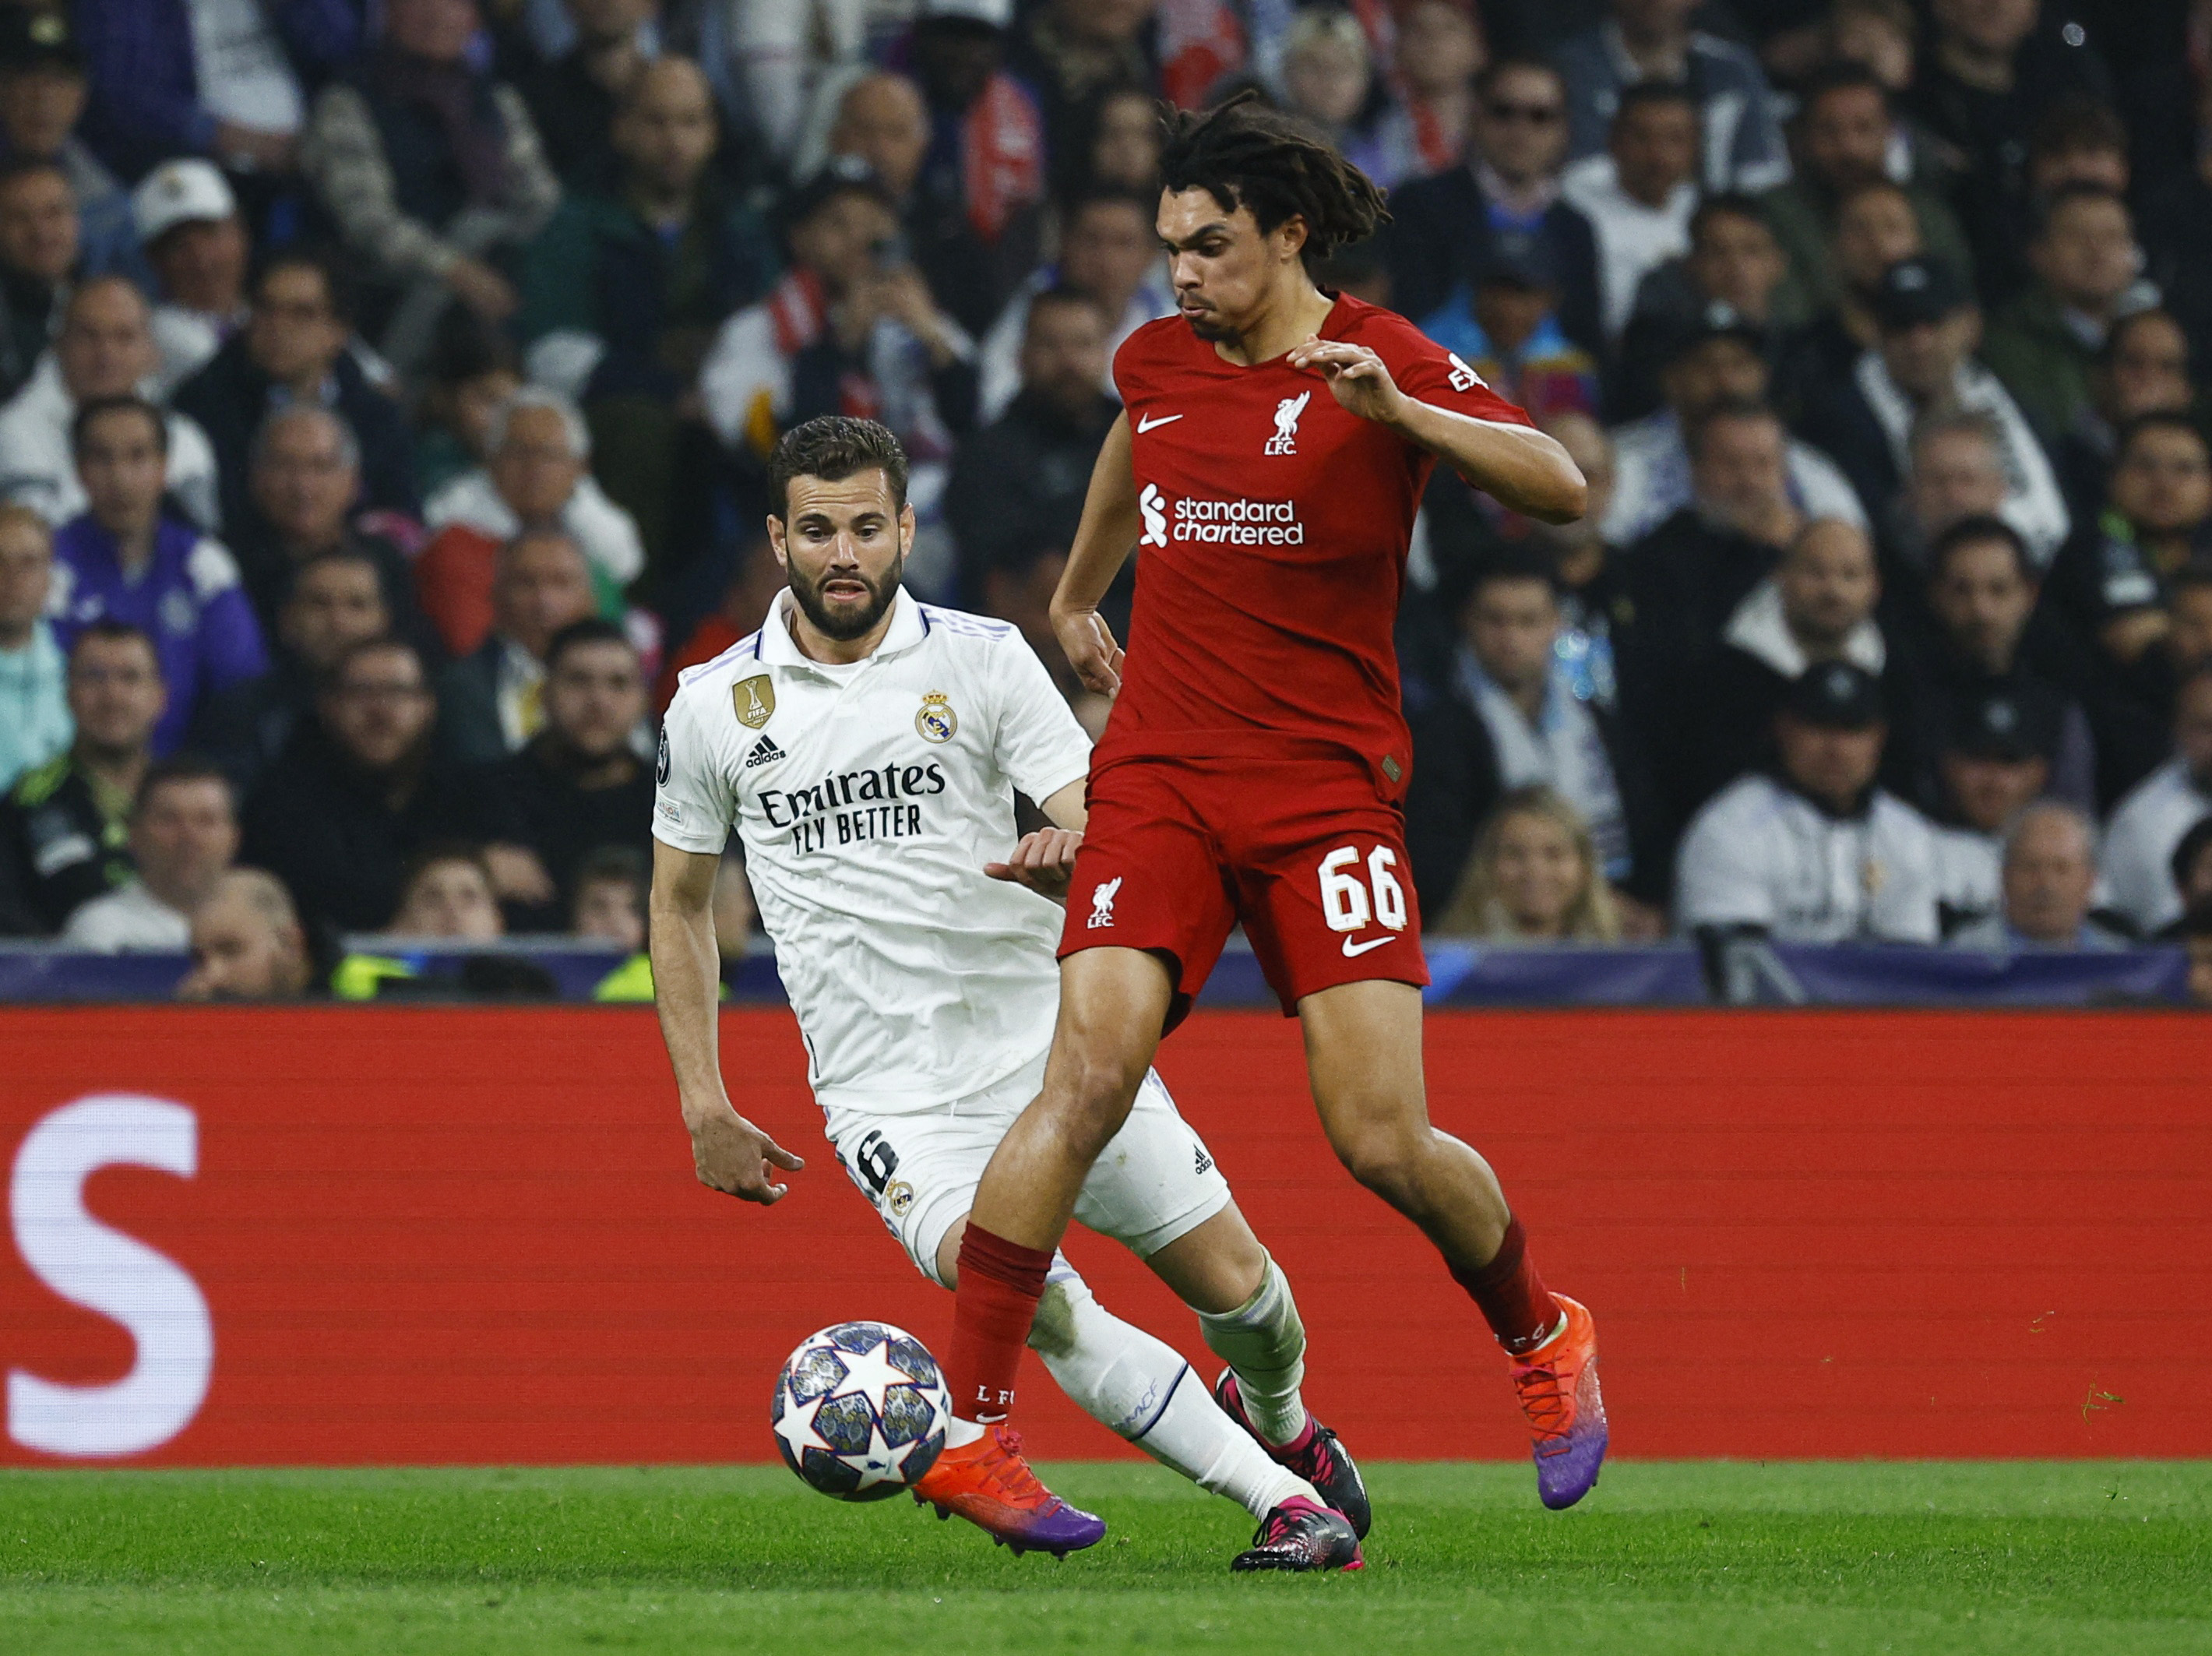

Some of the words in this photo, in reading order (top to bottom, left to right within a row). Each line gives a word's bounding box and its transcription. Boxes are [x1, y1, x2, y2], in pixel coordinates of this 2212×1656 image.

[1173, 520, 1303, 545] chartered
[1175, 496, 1294, 522] standard
[748, 707, 766, 719] FIFA
[745, 750, 786, 768] adidas
[757, 762, 946, 828] Emirates
[792, 817, 825, 855] FLY
[837, 804, 921, 844] BETTER
[1318, 844, 1407, 932] 66
[858, 1129, 900, 1195] 6
[7, 1092, 216, 1458] S
